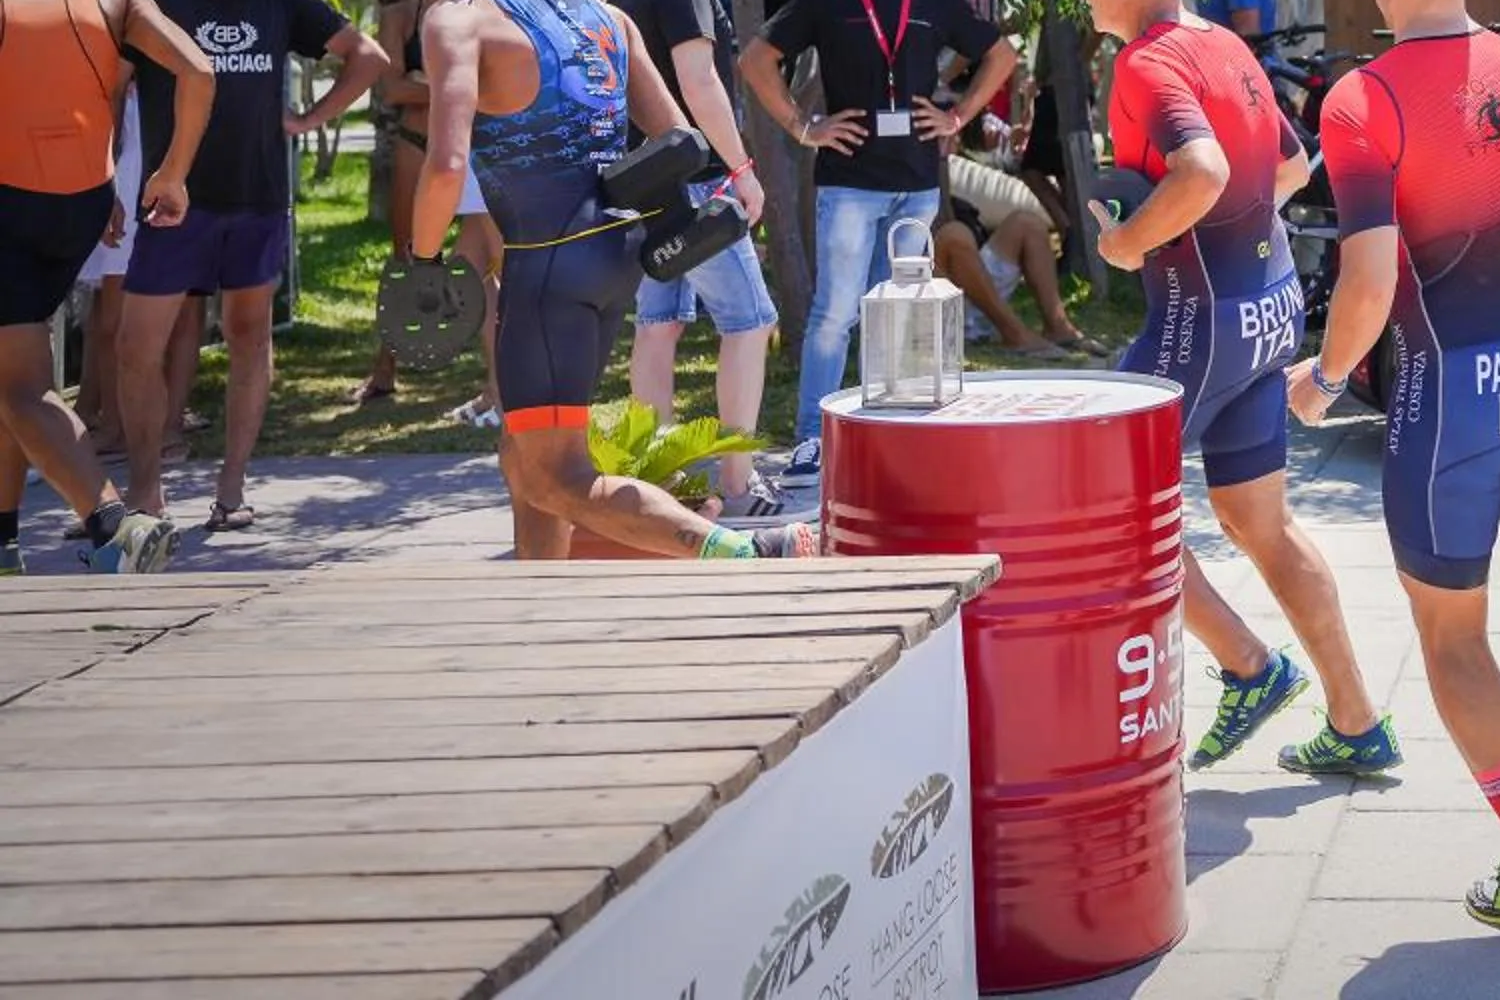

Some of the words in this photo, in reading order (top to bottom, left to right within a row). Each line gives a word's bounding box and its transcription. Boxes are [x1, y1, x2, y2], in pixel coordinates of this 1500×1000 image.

[1161, 266, 1181, 348] TRIATHLON
[1177, 296, 1199, 364] COSENZA
[1250, 319, 1296, 370] ITA
[1407, 350, 1427, 423] COSENZA
